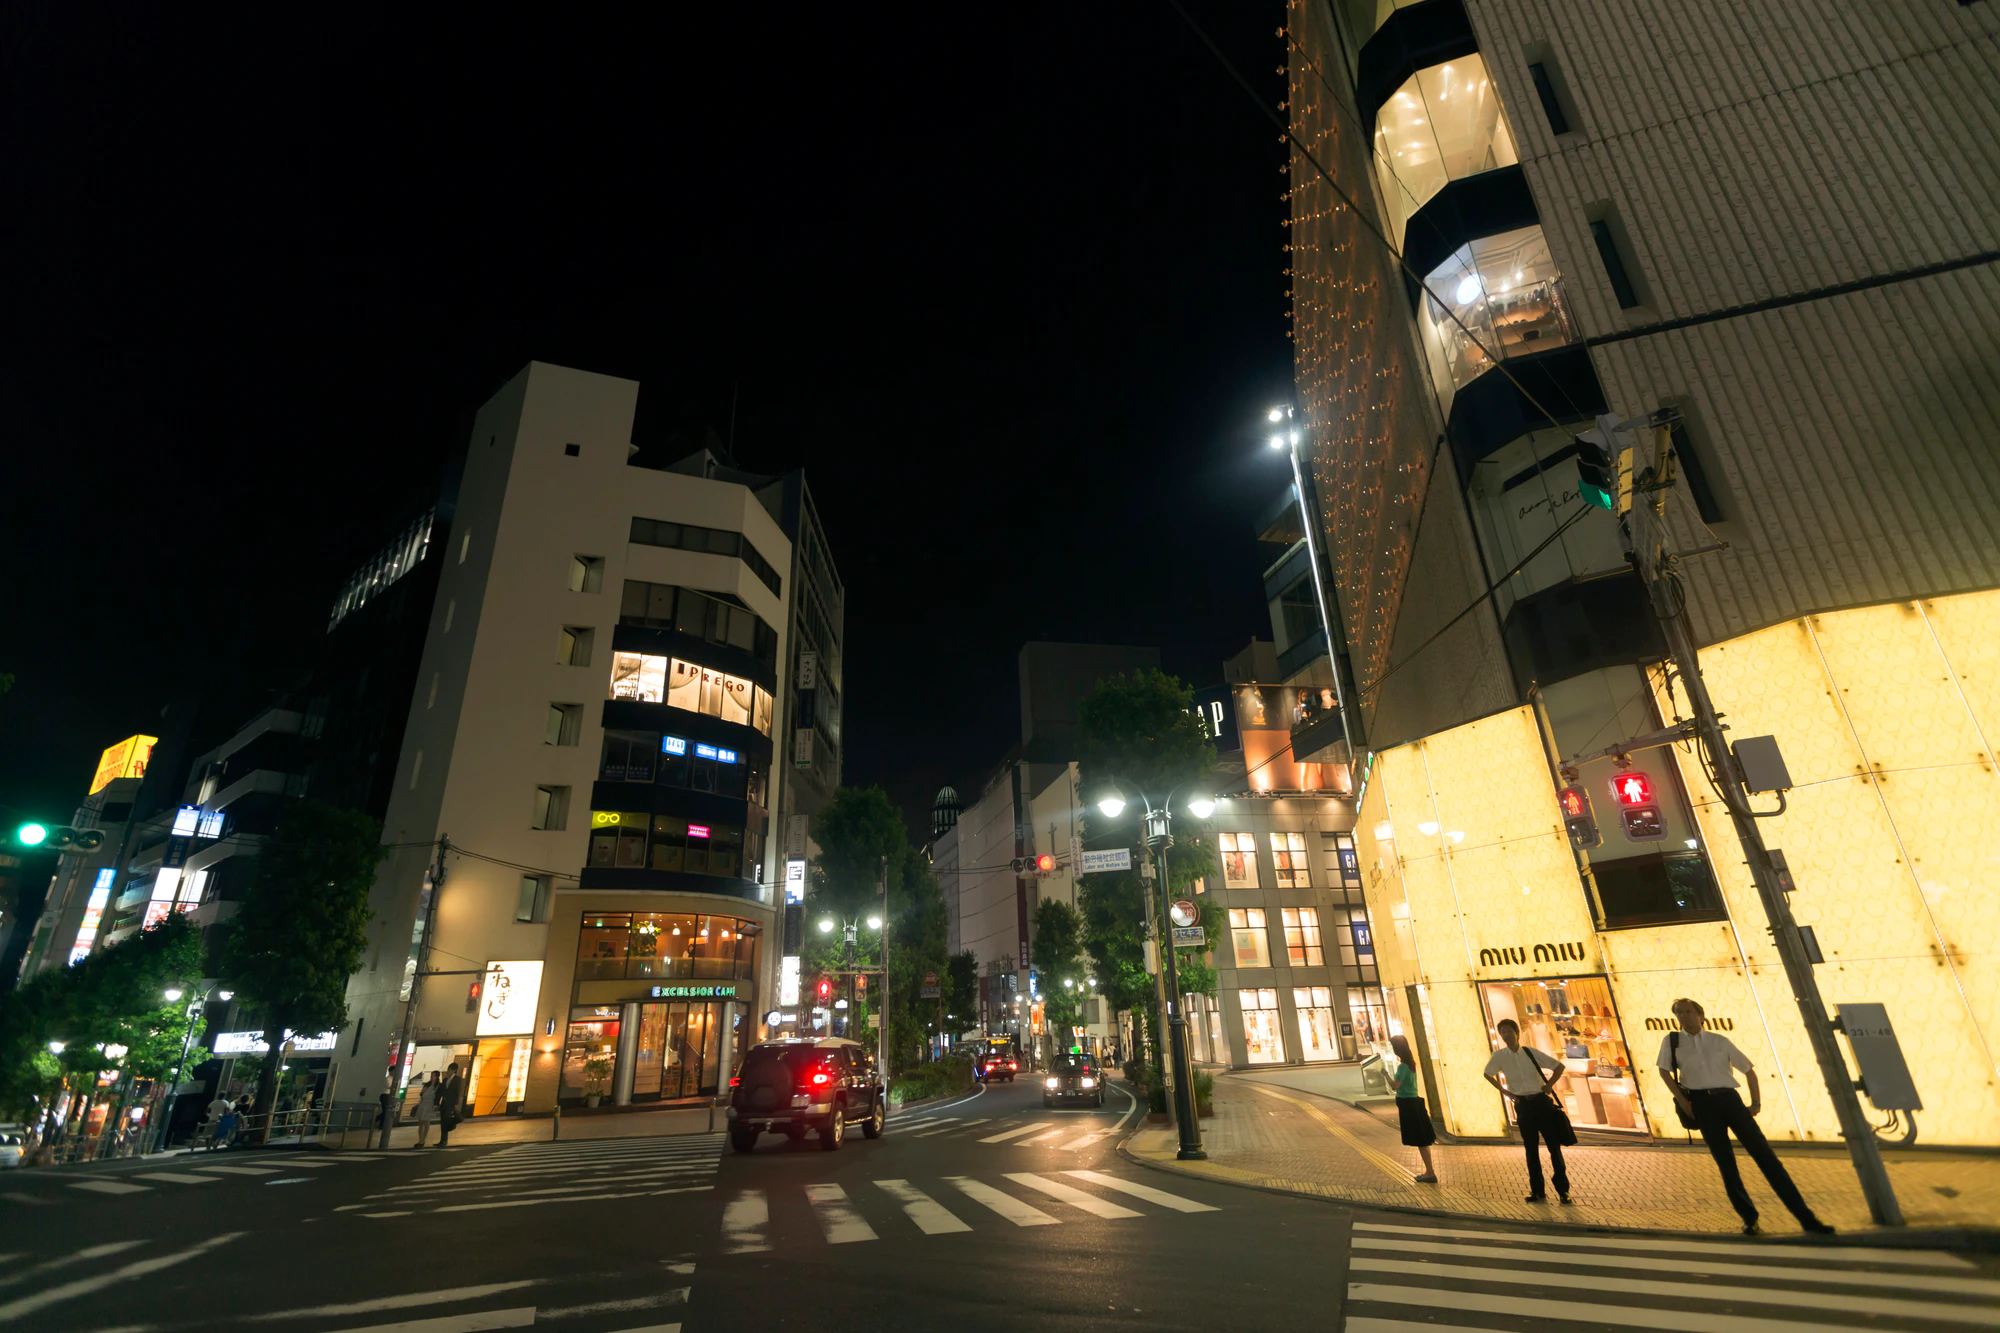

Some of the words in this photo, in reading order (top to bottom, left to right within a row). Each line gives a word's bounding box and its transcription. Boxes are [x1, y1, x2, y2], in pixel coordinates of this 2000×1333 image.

[690, 667, 744, 692] PREGO
[1182, 701, 1223, 739] AP
[1343, 853, 1357, 869] GA
[1357, 928, 1372, 946] GA
